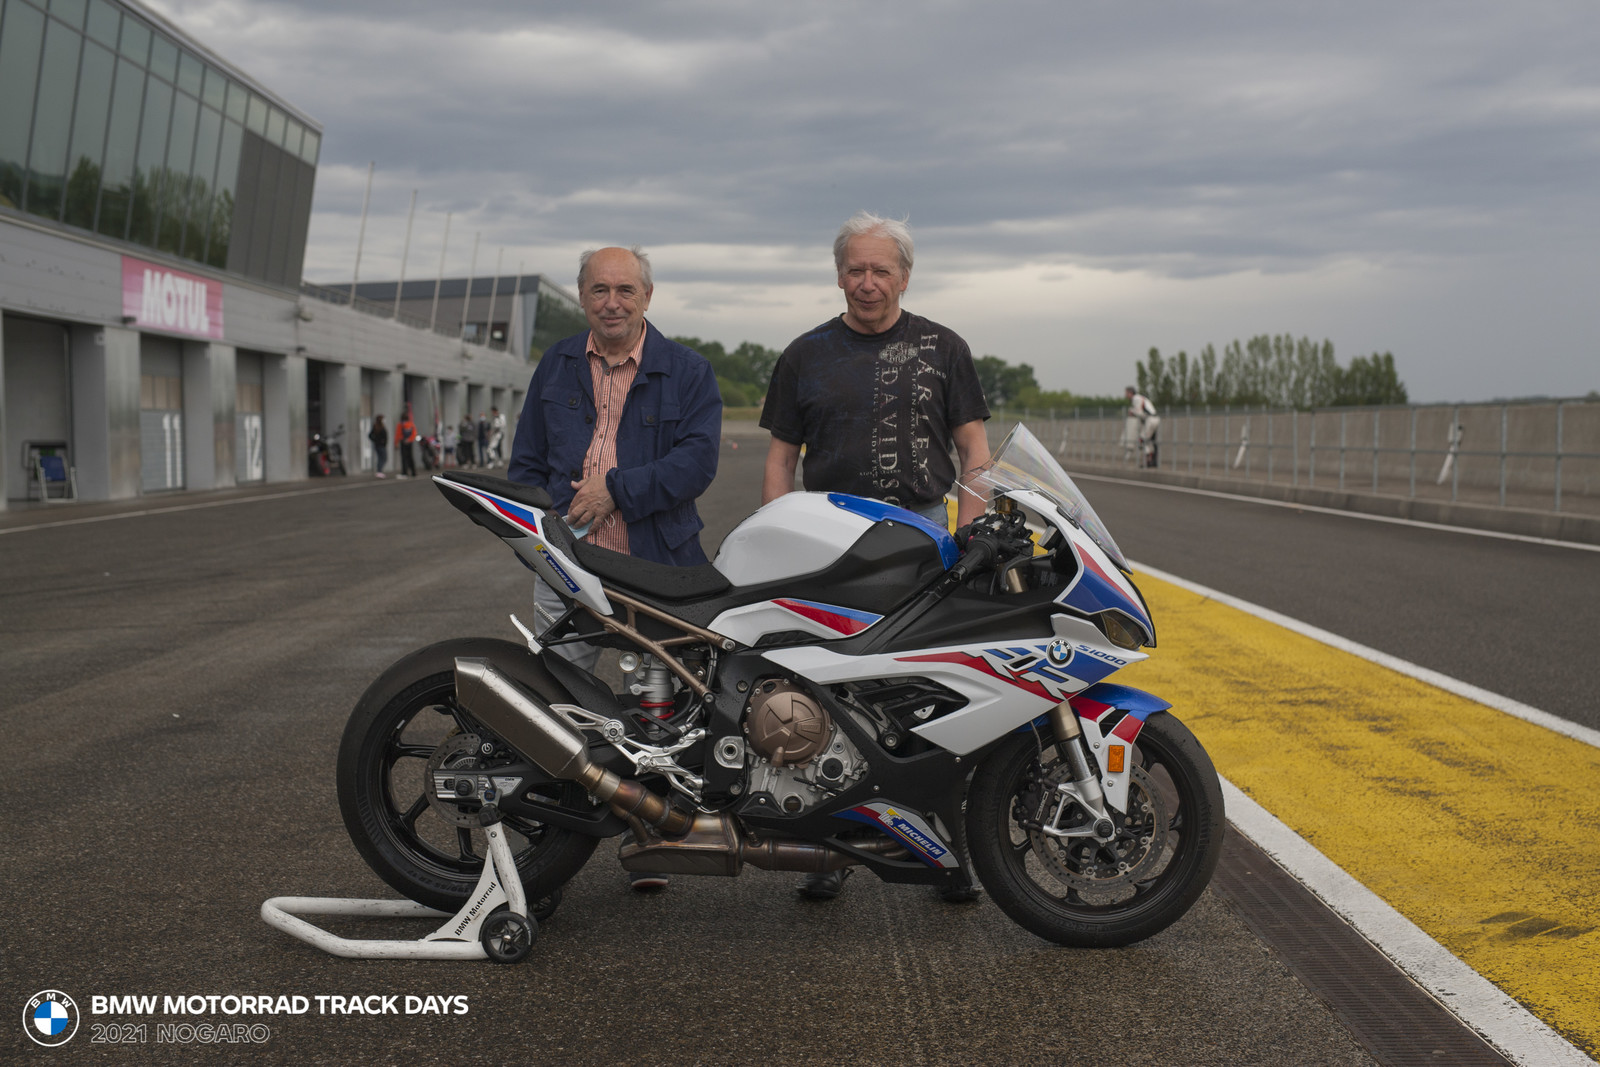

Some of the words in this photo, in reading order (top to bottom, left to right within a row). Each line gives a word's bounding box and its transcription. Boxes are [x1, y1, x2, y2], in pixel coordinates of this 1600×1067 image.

[141, 269, 210, 333] MOTUL
[162, 413, 183, 489] 11
[244, 414, 263, 481] 12
[897, 822, 943, 856] MICHELIN
[454, 915, 472, 937] BMW
[469, 881, 497, 917] Motorrad
